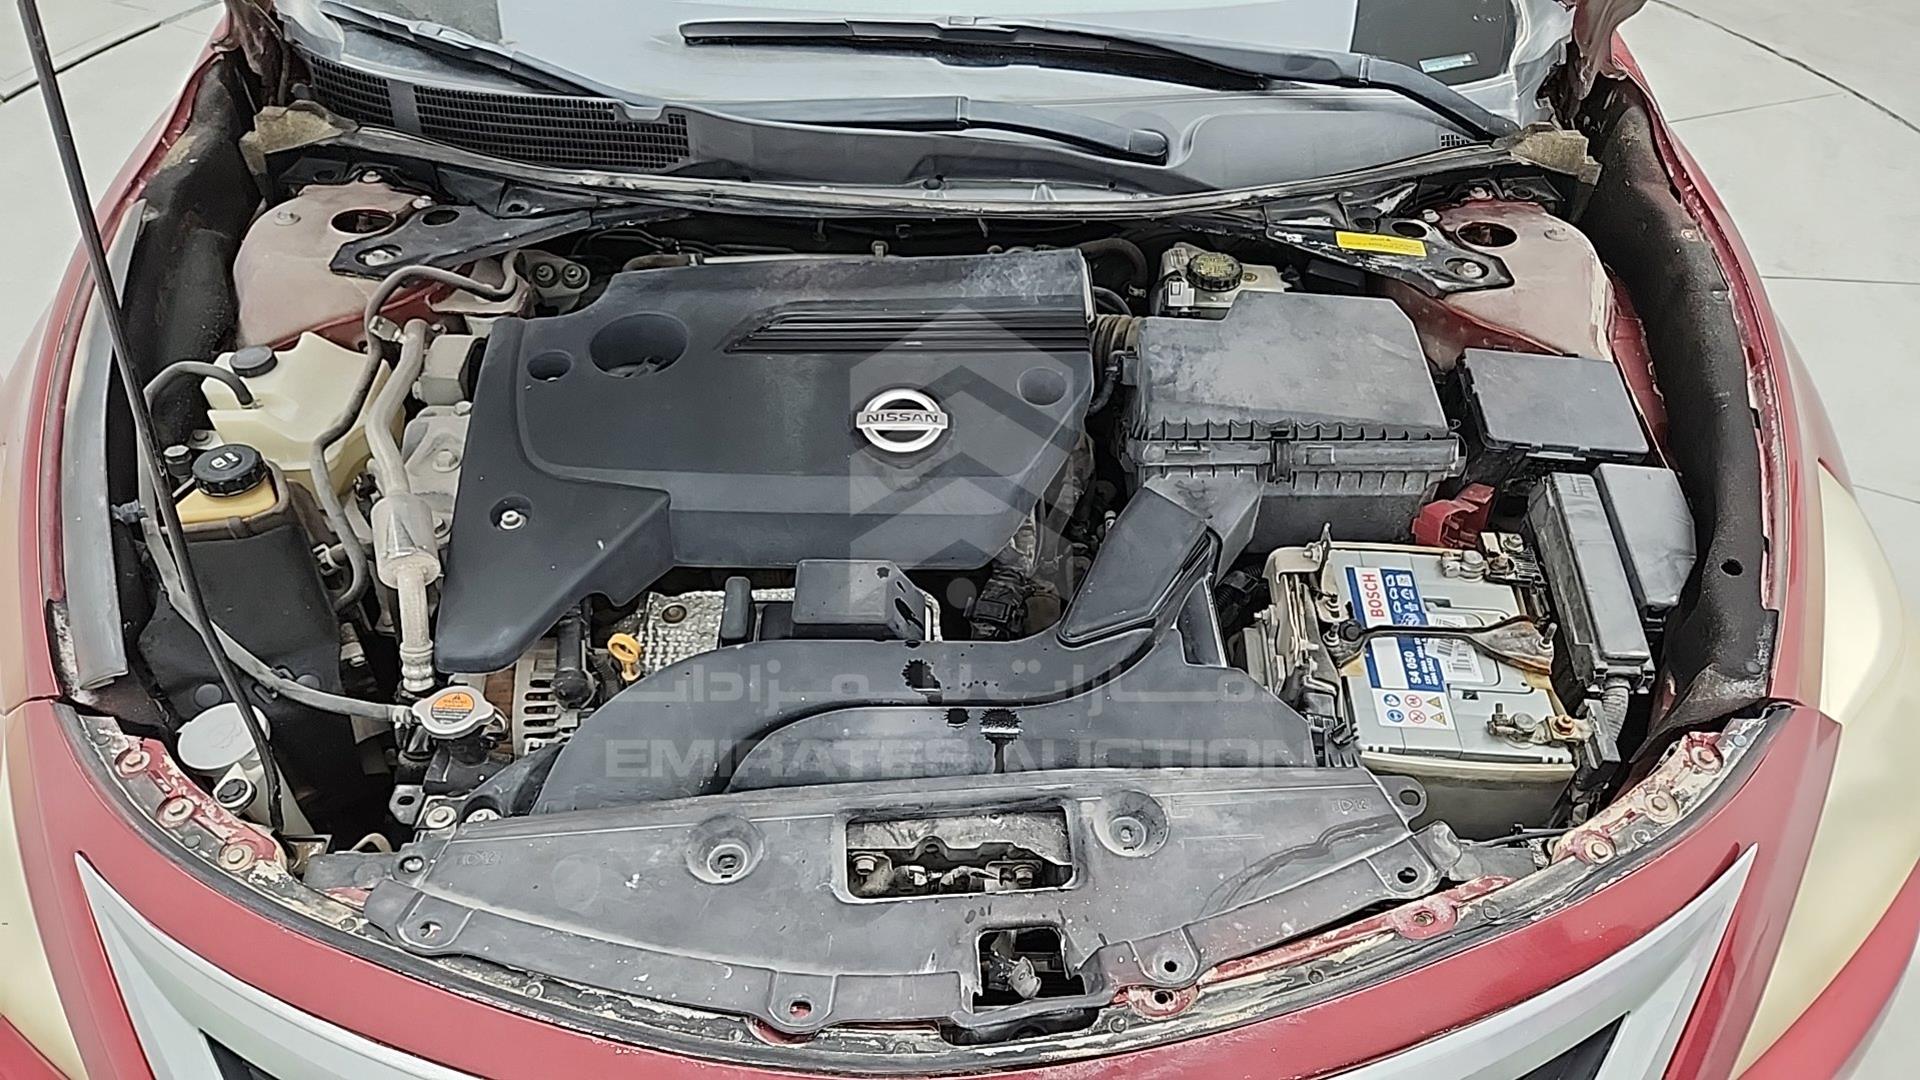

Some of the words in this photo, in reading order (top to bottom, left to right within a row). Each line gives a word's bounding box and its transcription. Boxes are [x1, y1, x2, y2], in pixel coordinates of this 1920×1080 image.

[866, 412, 938, 423] NISSAN
[1362, 574, 1384, 617] BOSCH
[1403, 650, 1418, 669] 050
[1408, 671, 1422, 684] S4
